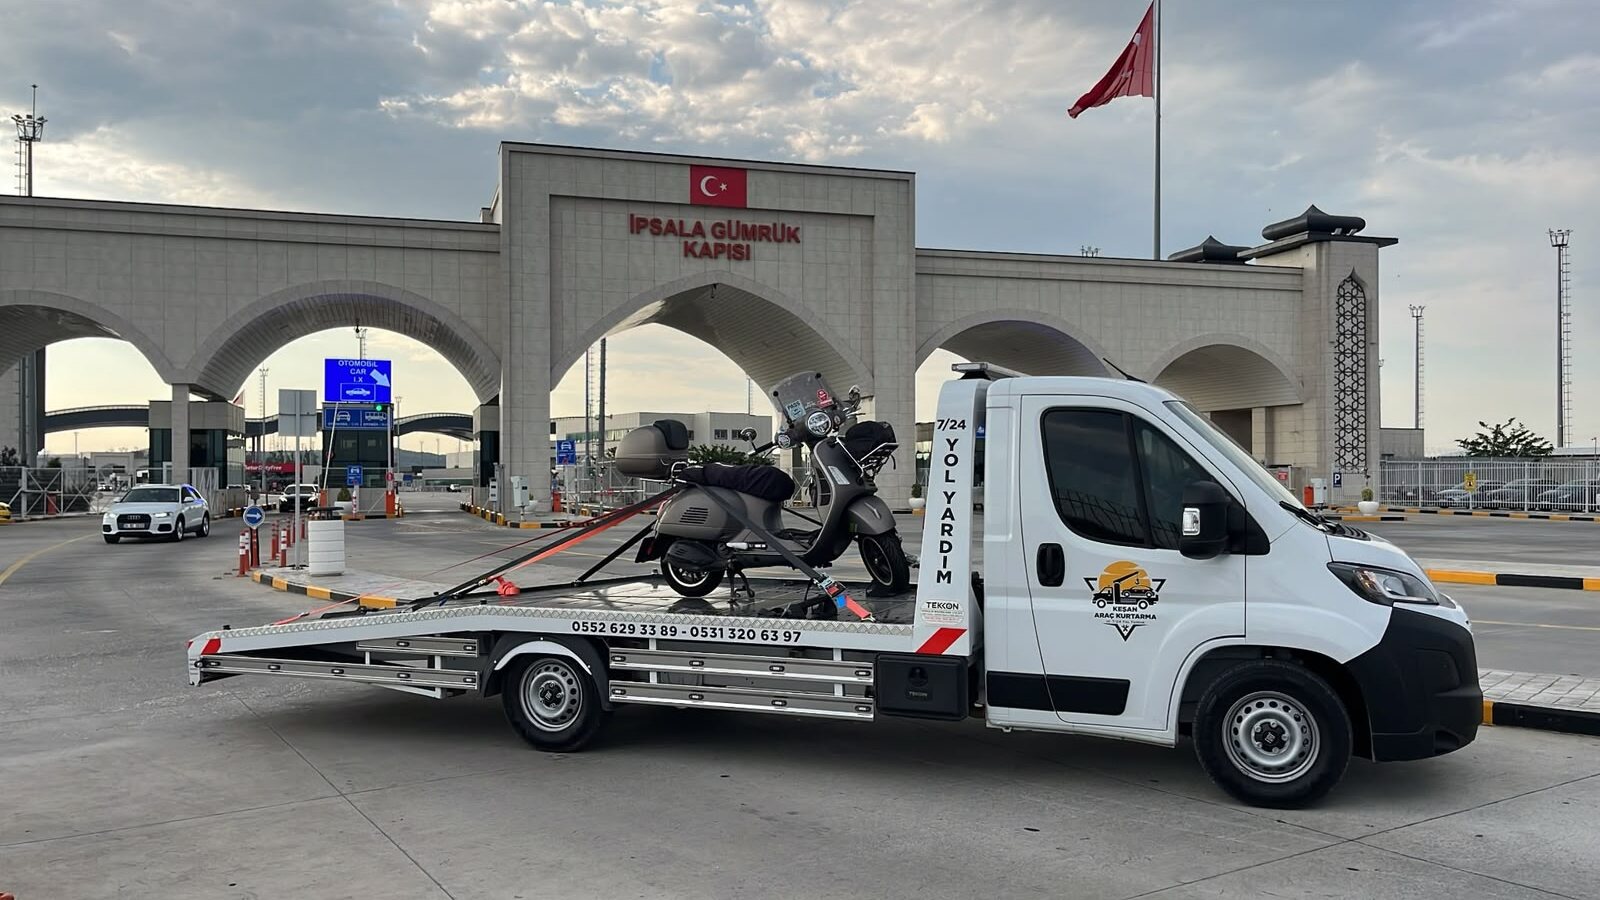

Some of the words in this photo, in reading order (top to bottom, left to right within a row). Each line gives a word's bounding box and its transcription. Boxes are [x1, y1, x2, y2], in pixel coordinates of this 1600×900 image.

[629, 213, 706, 238] İPSALA
[711, 220, 801, 243] GÜMRÜK
[683, 240, 751, 260] KAPISI
[936, 418, 966, 431] 7/24
[943, 438, 959, 483] YOL
[936, 491, 956, 584] YARDIM
[572, 621, 606, 632] 0552
[610, 623, 636, 634] 629
[640, 624, 656, 635] 33
[660, 625, 677, 636] 89
[690, 626, 724, 638] 0531
[728, 628, 756, 640] 320
[760, 629, 778, 641] 63
[783, 631, 801, 642] 97
